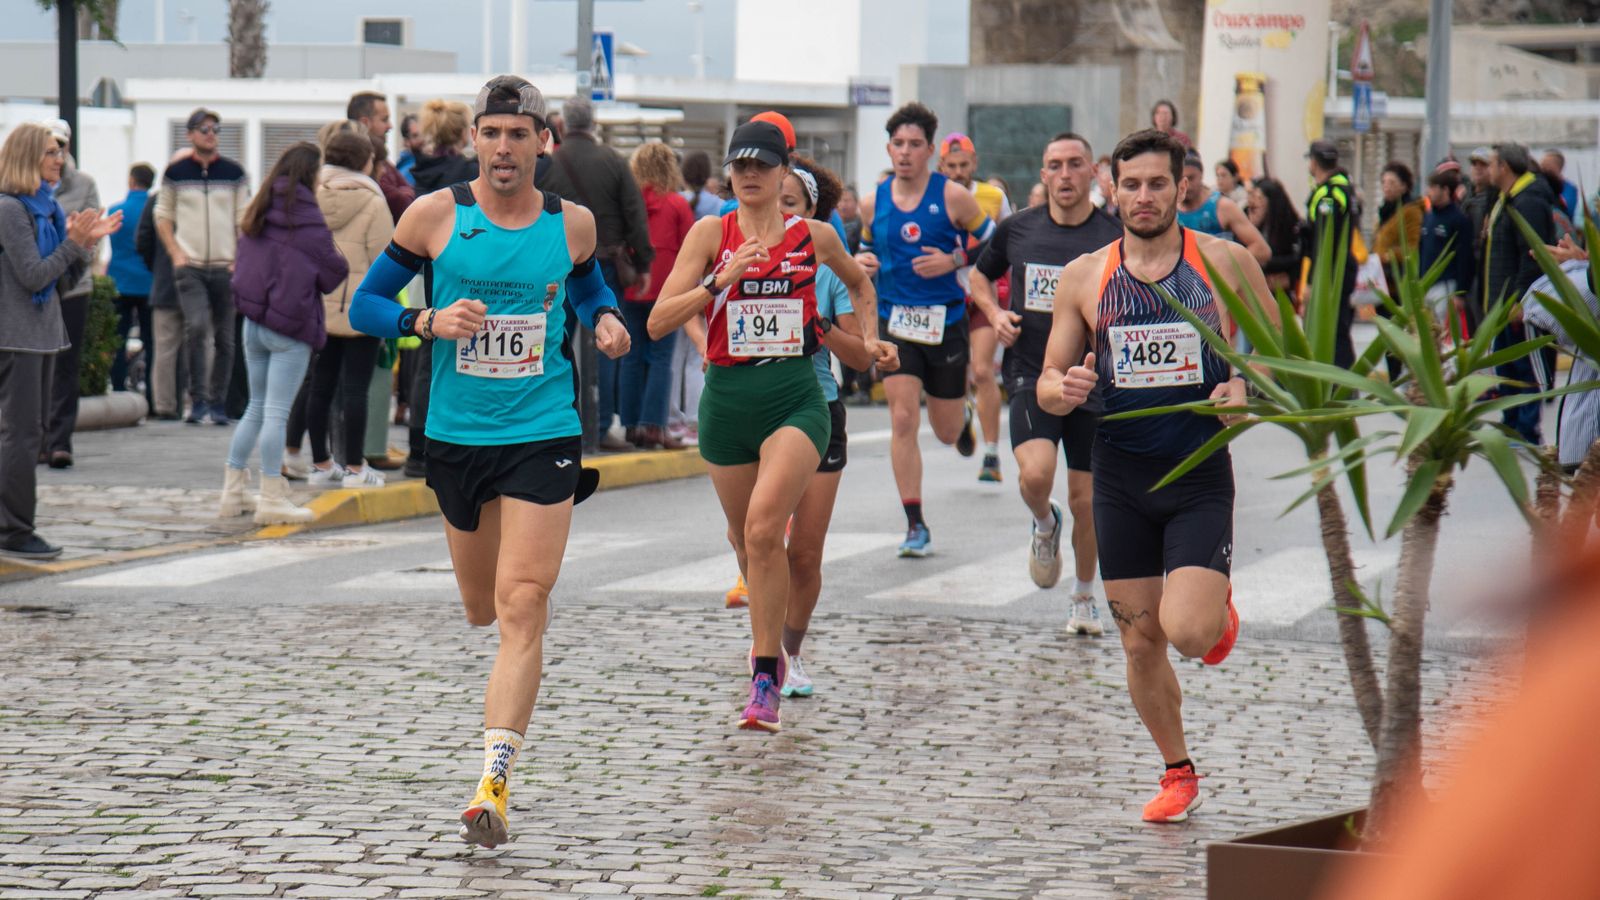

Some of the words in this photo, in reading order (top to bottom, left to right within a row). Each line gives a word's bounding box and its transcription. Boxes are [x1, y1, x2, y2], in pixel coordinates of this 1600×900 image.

[461, 278, 535, 290] AYUNTAMIENTO
[761, 280, 790, 294] BM
[1040, 277, 1059, 296] 29
[470, 287, 482, 295] DE
[740, 304, 763, 314] XIV
[480, 320, 500, 331] IV
[753, 315, 779, 336] 94
[904, 312, 930, 329] 394
[1124, 330, 1150, 342] XIV
[480, 332, 524, 356] 116
[1132, 341, 1177, 365] 482
[493, 743, 516, 755] WAKE
[498, 751, 510, 759] UP
[493, 759, 508, 770] AND
